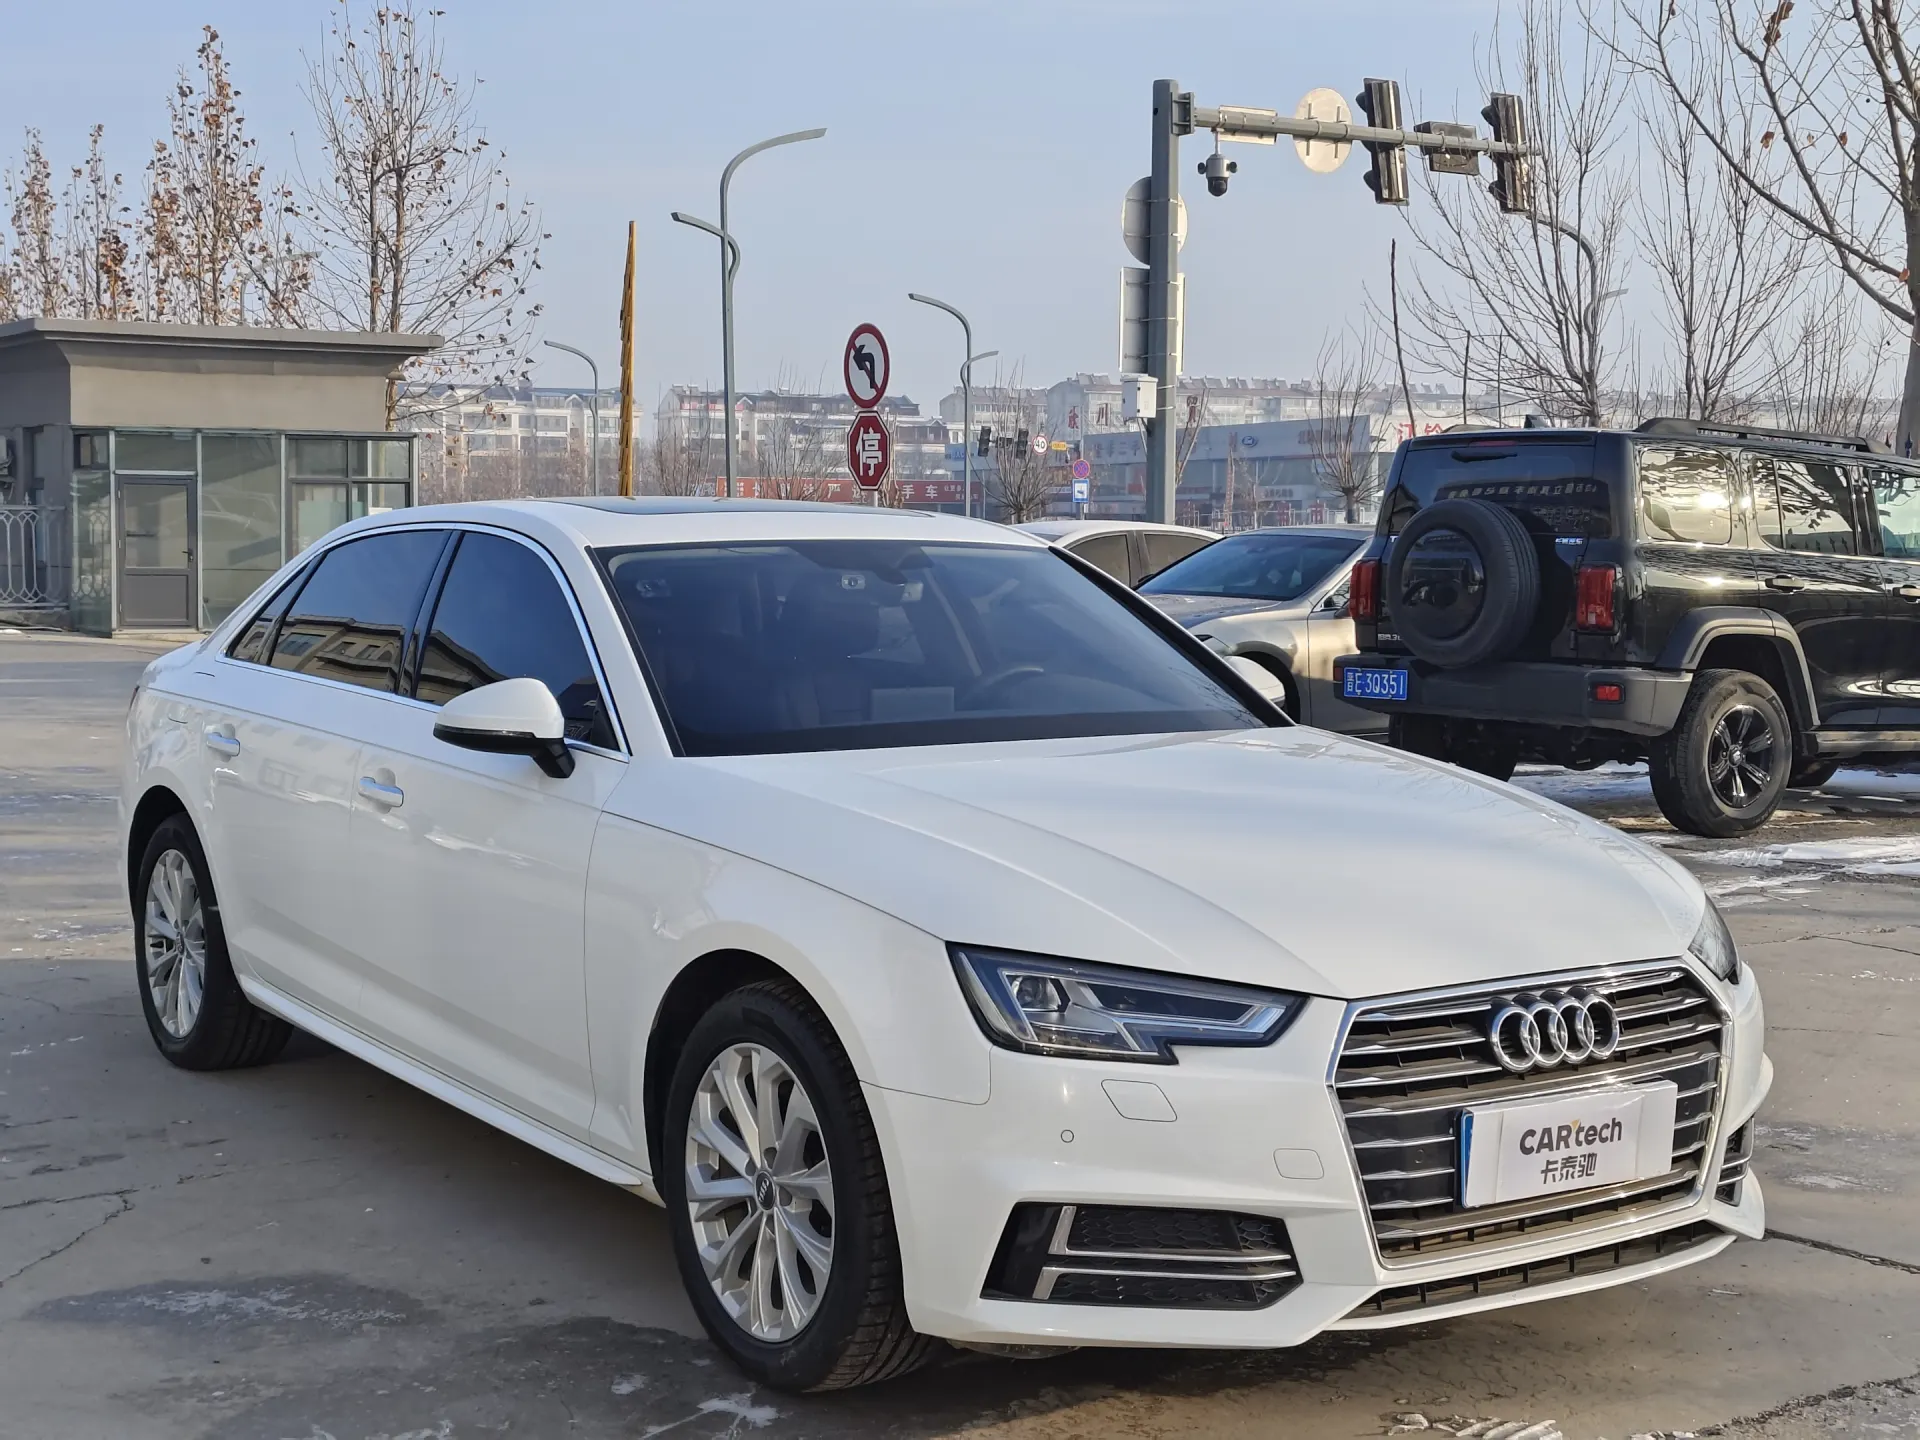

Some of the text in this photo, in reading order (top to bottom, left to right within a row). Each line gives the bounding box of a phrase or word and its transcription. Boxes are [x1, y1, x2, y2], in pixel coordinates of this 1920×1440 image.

[856, 427, 882, 476] 停
[1034, 439, 1047, 450] 40
[1519, 1117, 1623, 1156] CARtech
[1540, 1152, 1598, 1185] 卡泰驰
